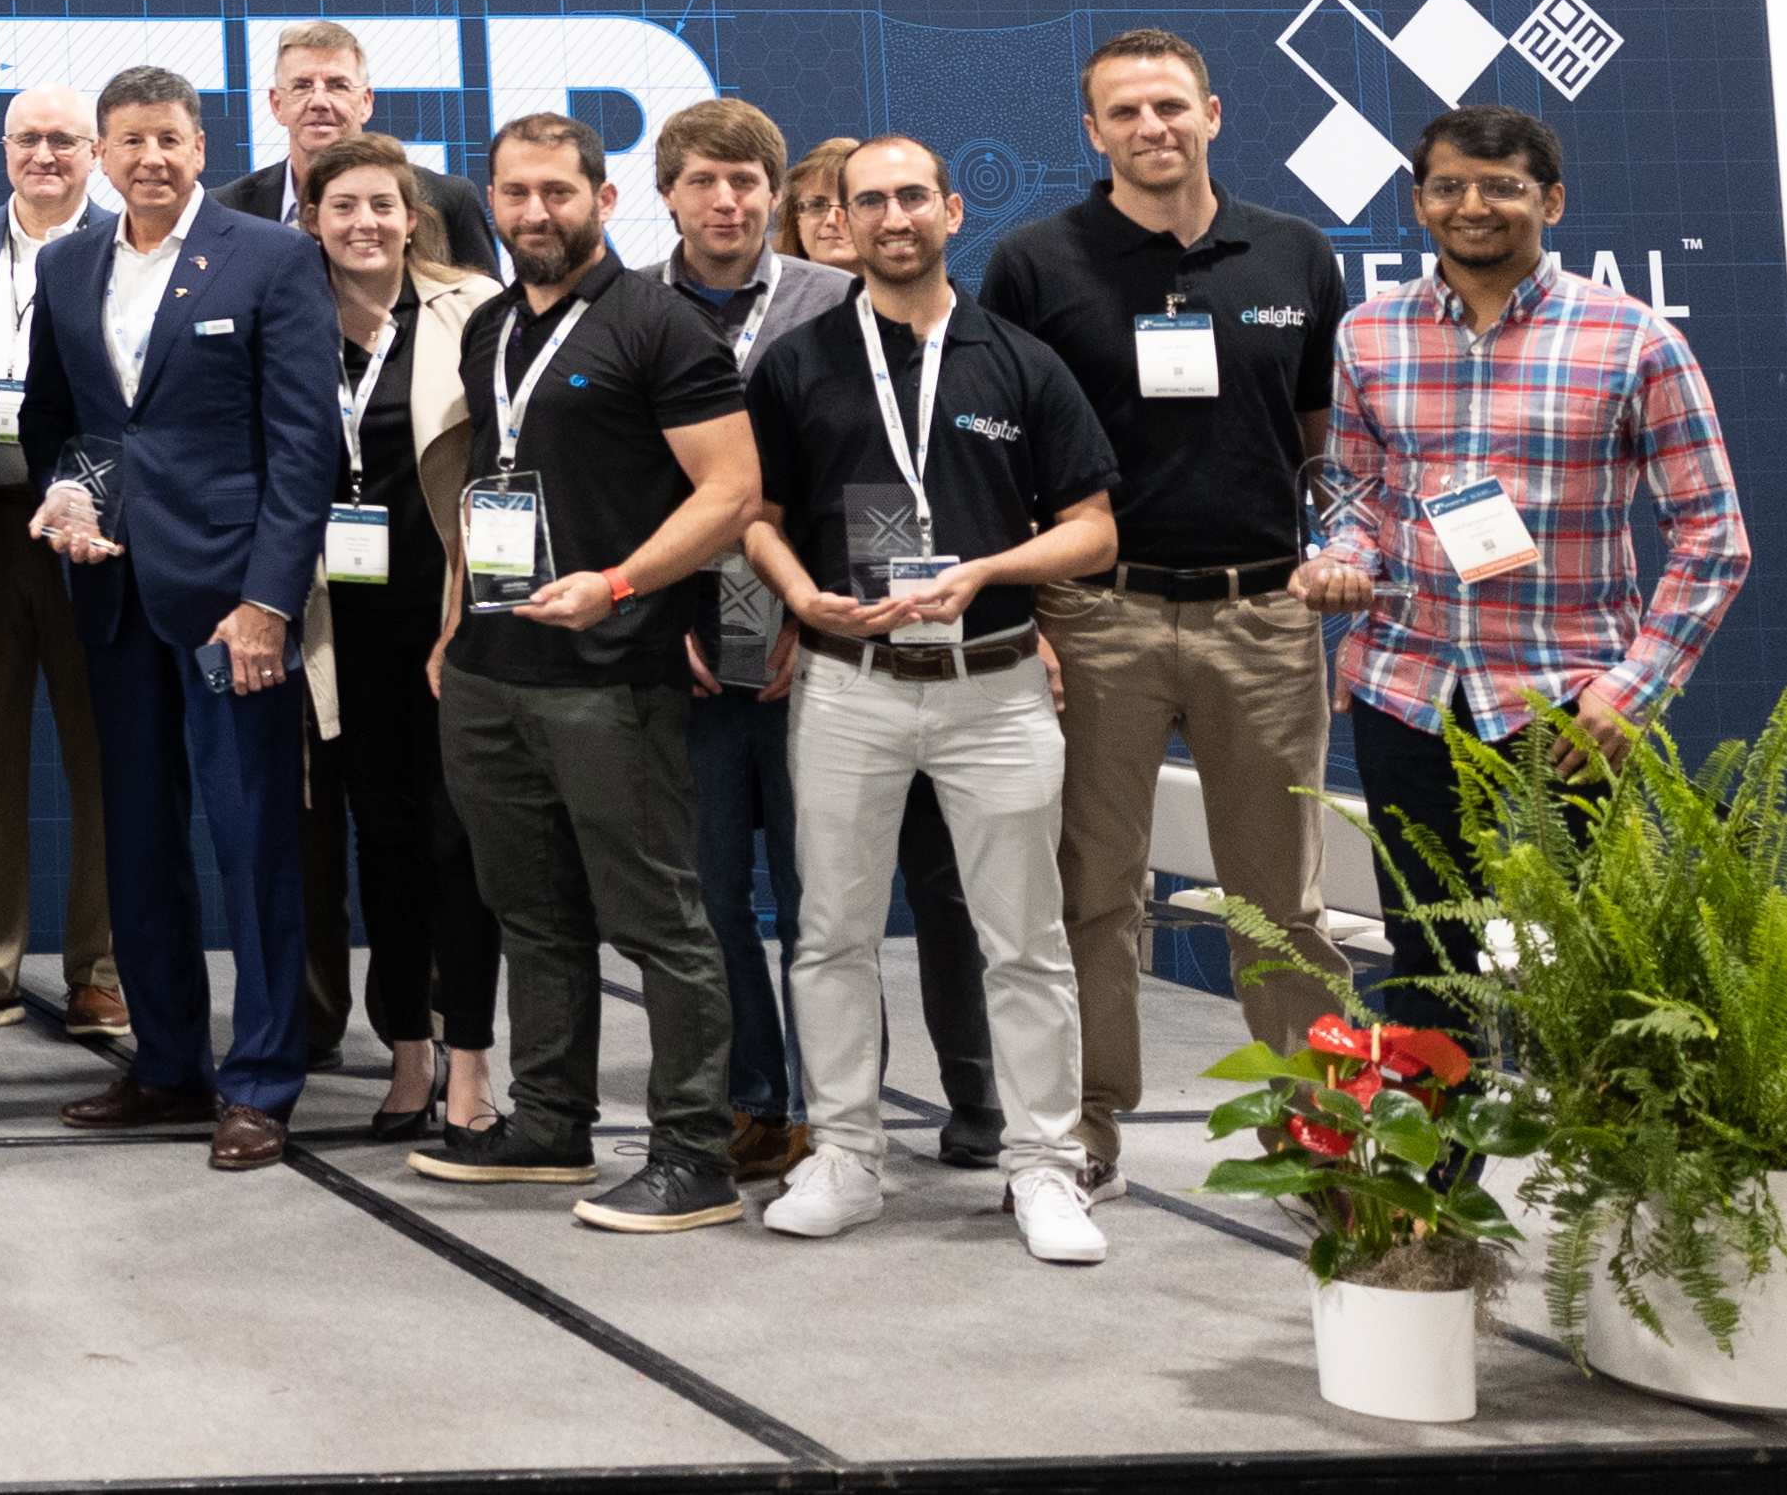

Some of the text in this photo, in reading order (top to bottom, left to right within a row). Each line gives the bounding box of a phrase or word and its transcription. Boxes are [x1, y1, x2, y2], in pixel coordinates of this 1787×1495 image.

[1240, 305, 1306, 328] elsight
[885, 392, 900, 430] Auterion
[955, 412, 1021, 441] elsight
